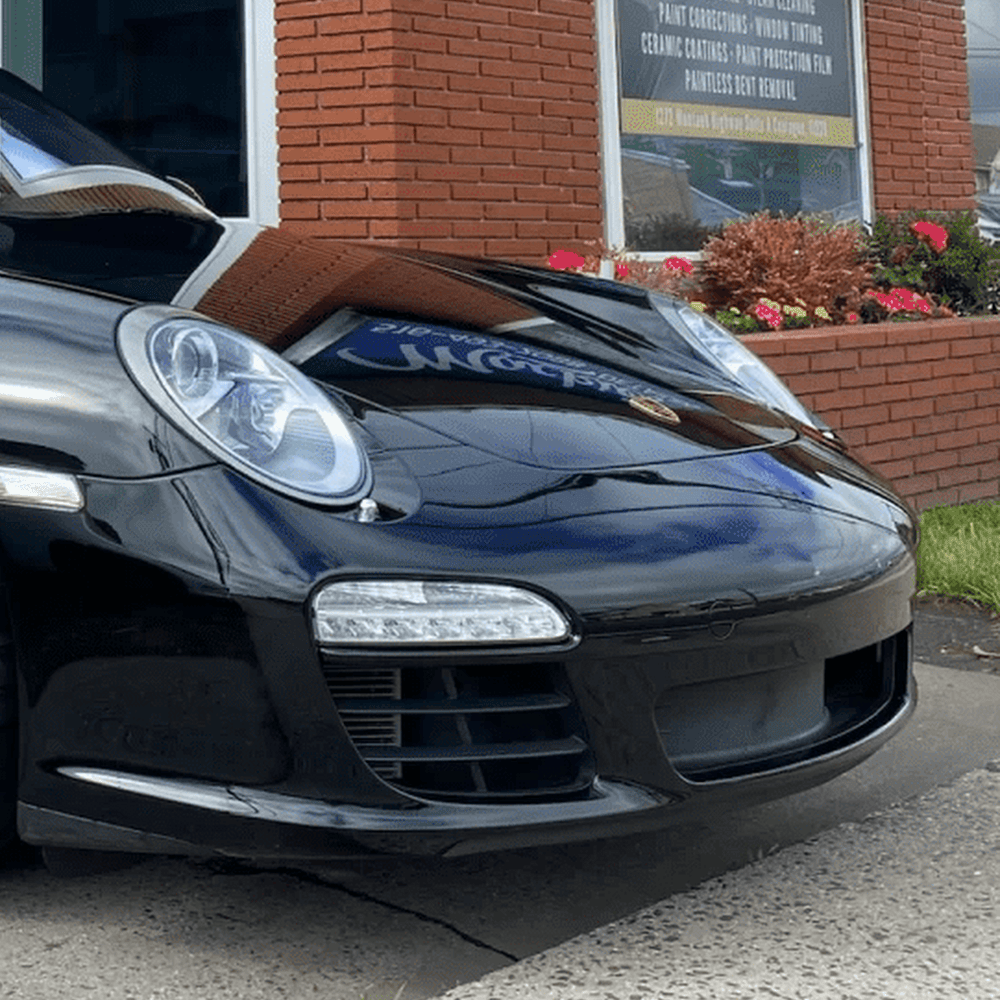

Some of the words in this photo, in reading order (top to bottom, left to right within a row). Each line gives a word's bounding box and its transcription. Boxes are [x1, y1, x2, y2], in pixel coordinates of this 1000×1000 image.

[658, 1, 687, 27] PAINT
[640, 31, 683, 59] CERAMIC
[684, 37, 728, 63] COATINGS
[735, 43, 761, 67] PAINT
[762, 47, 812, 73] PROTECTION
[813, 52, 833, 76] FILM
[684, 68, 733, 95] PAINTLESS
[734, 72, 757, 97] DENT
[758, 76, 797, 101] REMOVAL
